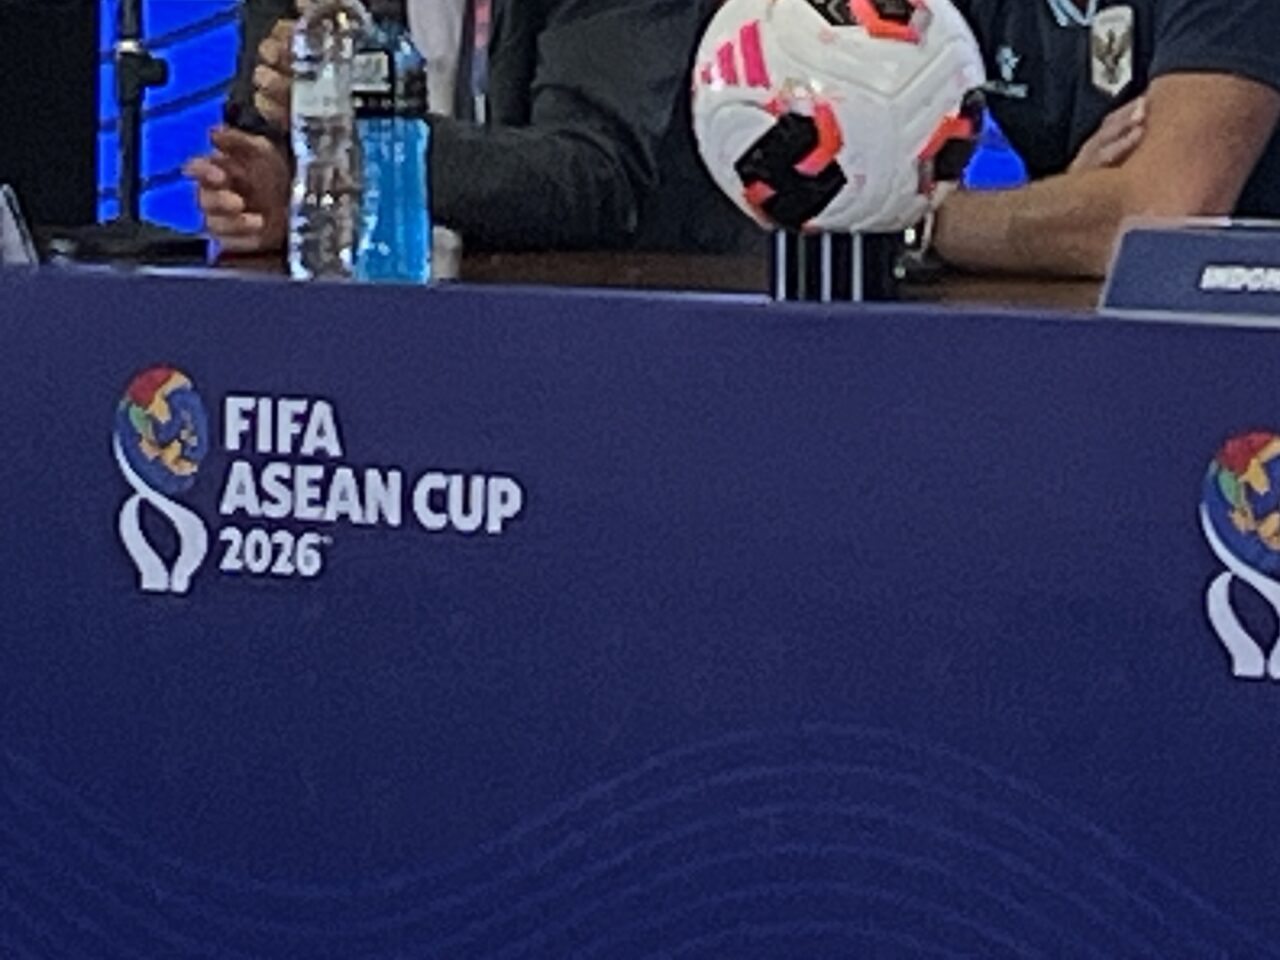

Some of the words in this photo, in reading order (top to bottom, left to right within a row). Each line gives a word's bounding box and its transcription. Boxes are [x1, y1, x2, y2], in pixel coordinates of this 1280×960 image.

[224, 396, 342, 457] FIFA
[219, 461, 402, 526] ASEAN
[412, 471, 523, 534] CUP
